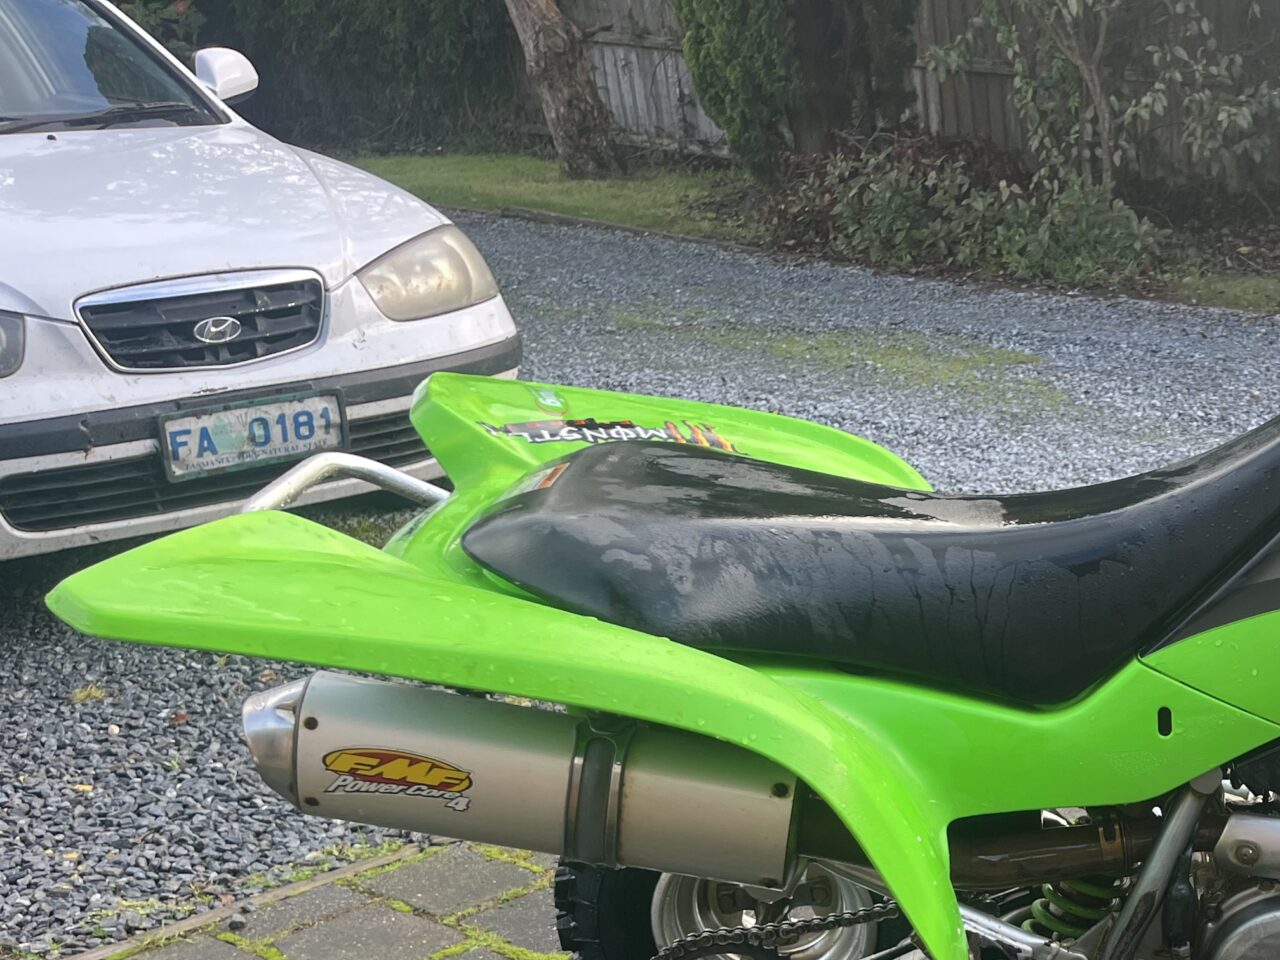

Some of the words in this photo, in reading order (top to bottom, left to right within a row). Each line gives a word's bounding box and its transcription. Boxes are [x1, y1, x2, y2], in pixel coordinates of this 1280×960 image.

[169, 426, 219, 461] FA
[249, 406, 331, 447] 0181
[325, 752, 471, 786] FMF
